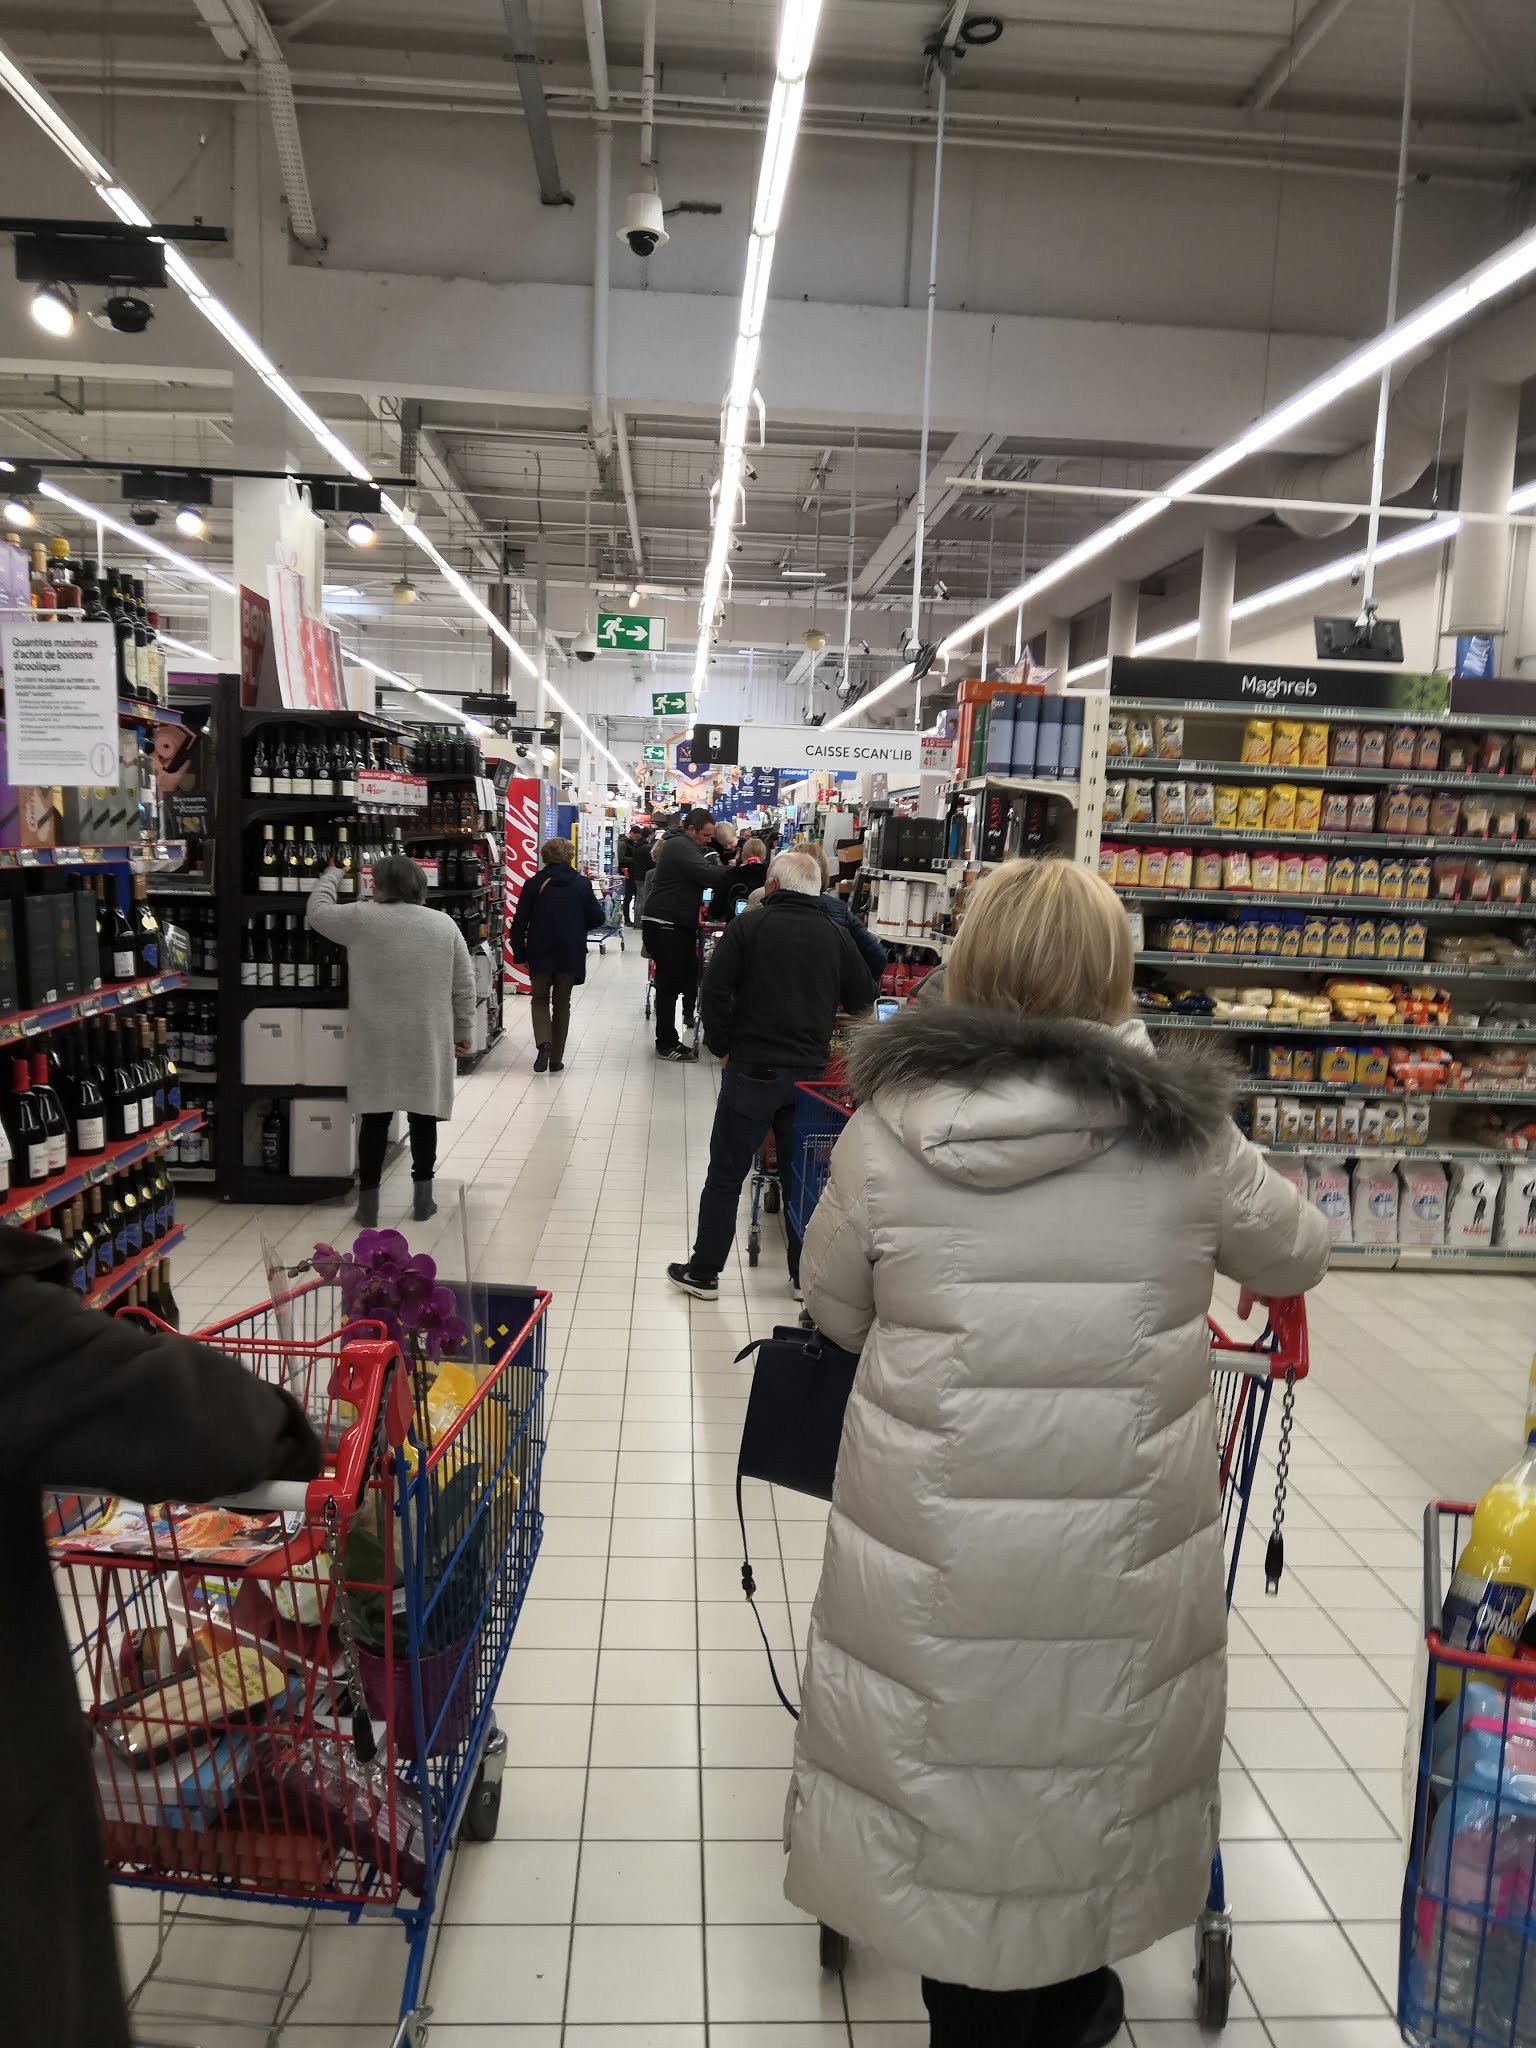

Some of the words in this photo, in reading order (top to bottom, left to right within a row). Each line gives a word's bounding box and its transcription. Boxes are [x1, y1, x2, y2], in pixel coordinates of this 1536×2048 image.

[12, 637, 52, 647] Quantités
[54, 637, 98, 648] maximales
[13, 649, 43, 659] d'achat
[45, 649, 55, 659] de
[57, 649, 93, 660] boissons
[14, 661, 61, 672] alcooliques
[1241, 675, 1317, 698] Maghreb
[805, 745, 850, 758] CAISSE
[854, 746, 912, 761] SCAN'LIB
